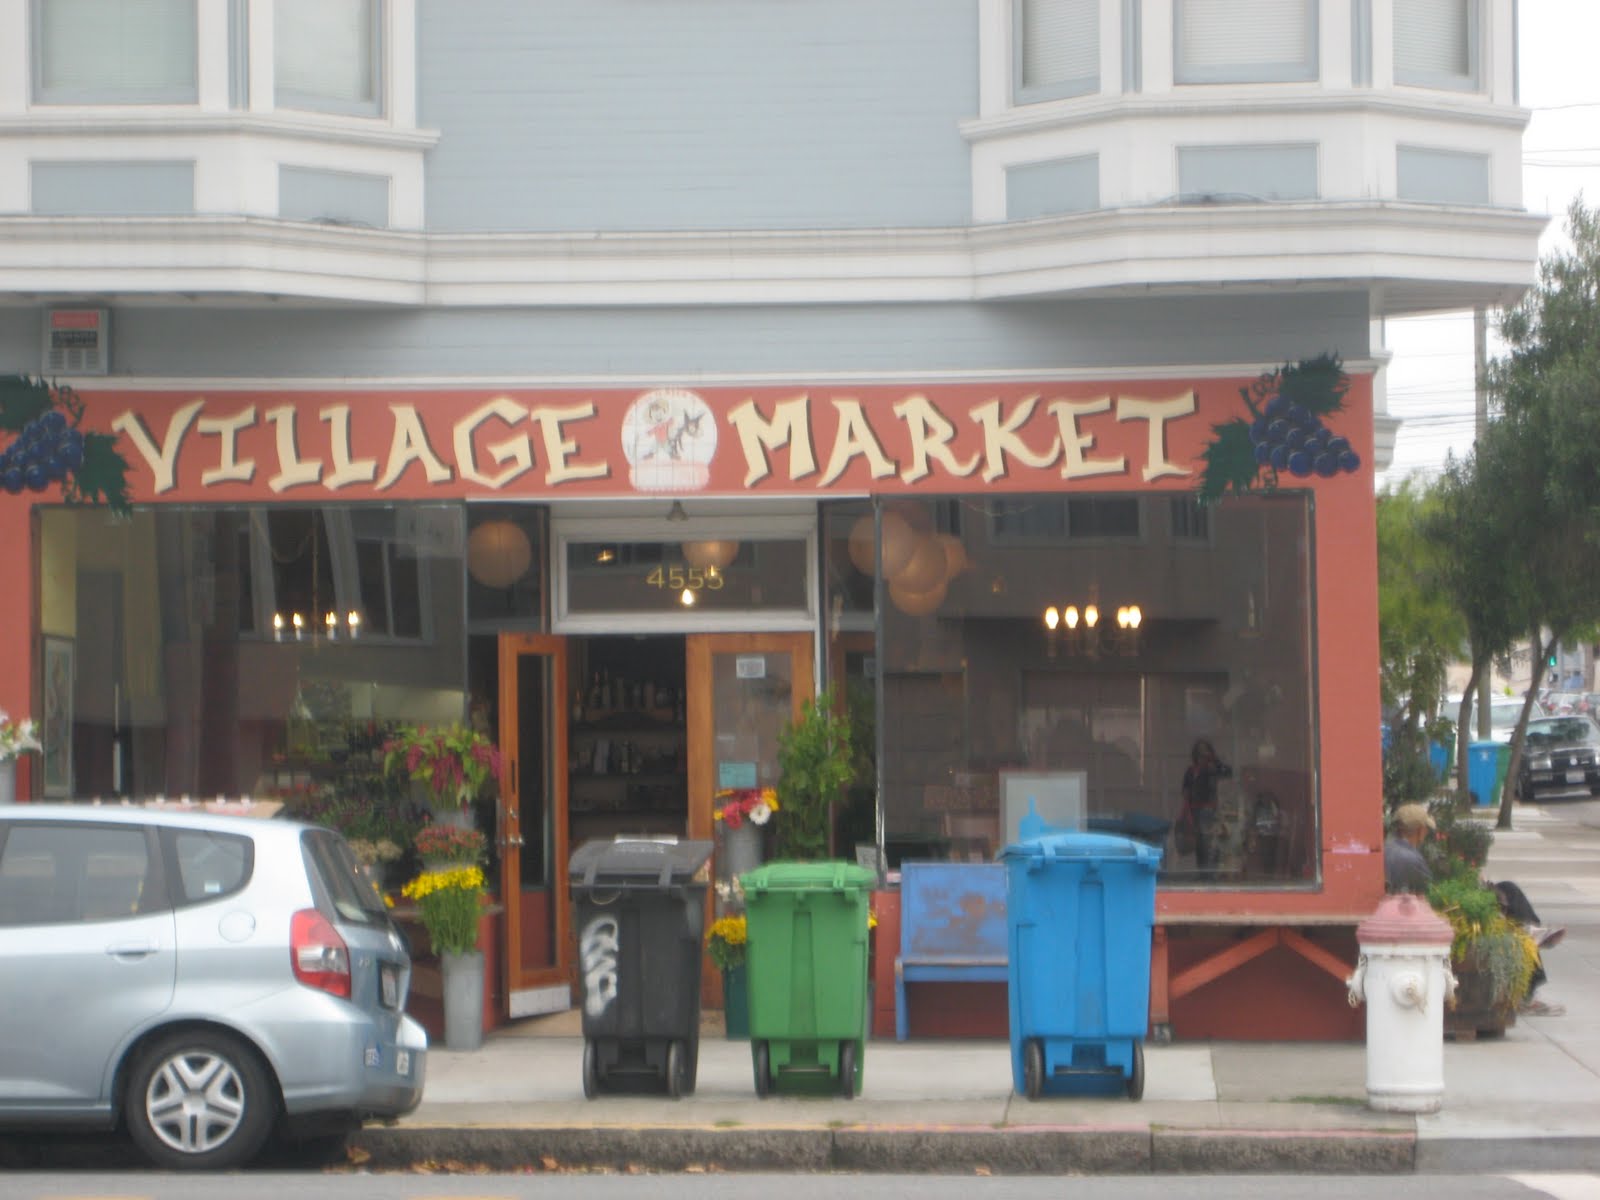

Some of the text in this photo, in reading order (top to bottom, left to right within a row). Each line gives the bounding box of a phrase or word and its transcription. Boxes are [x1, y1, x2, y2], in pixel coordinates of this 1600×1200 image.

[111, 390, 1196, 495] VILLAGE MARKET
[646, 565, 724, 590] 4555
